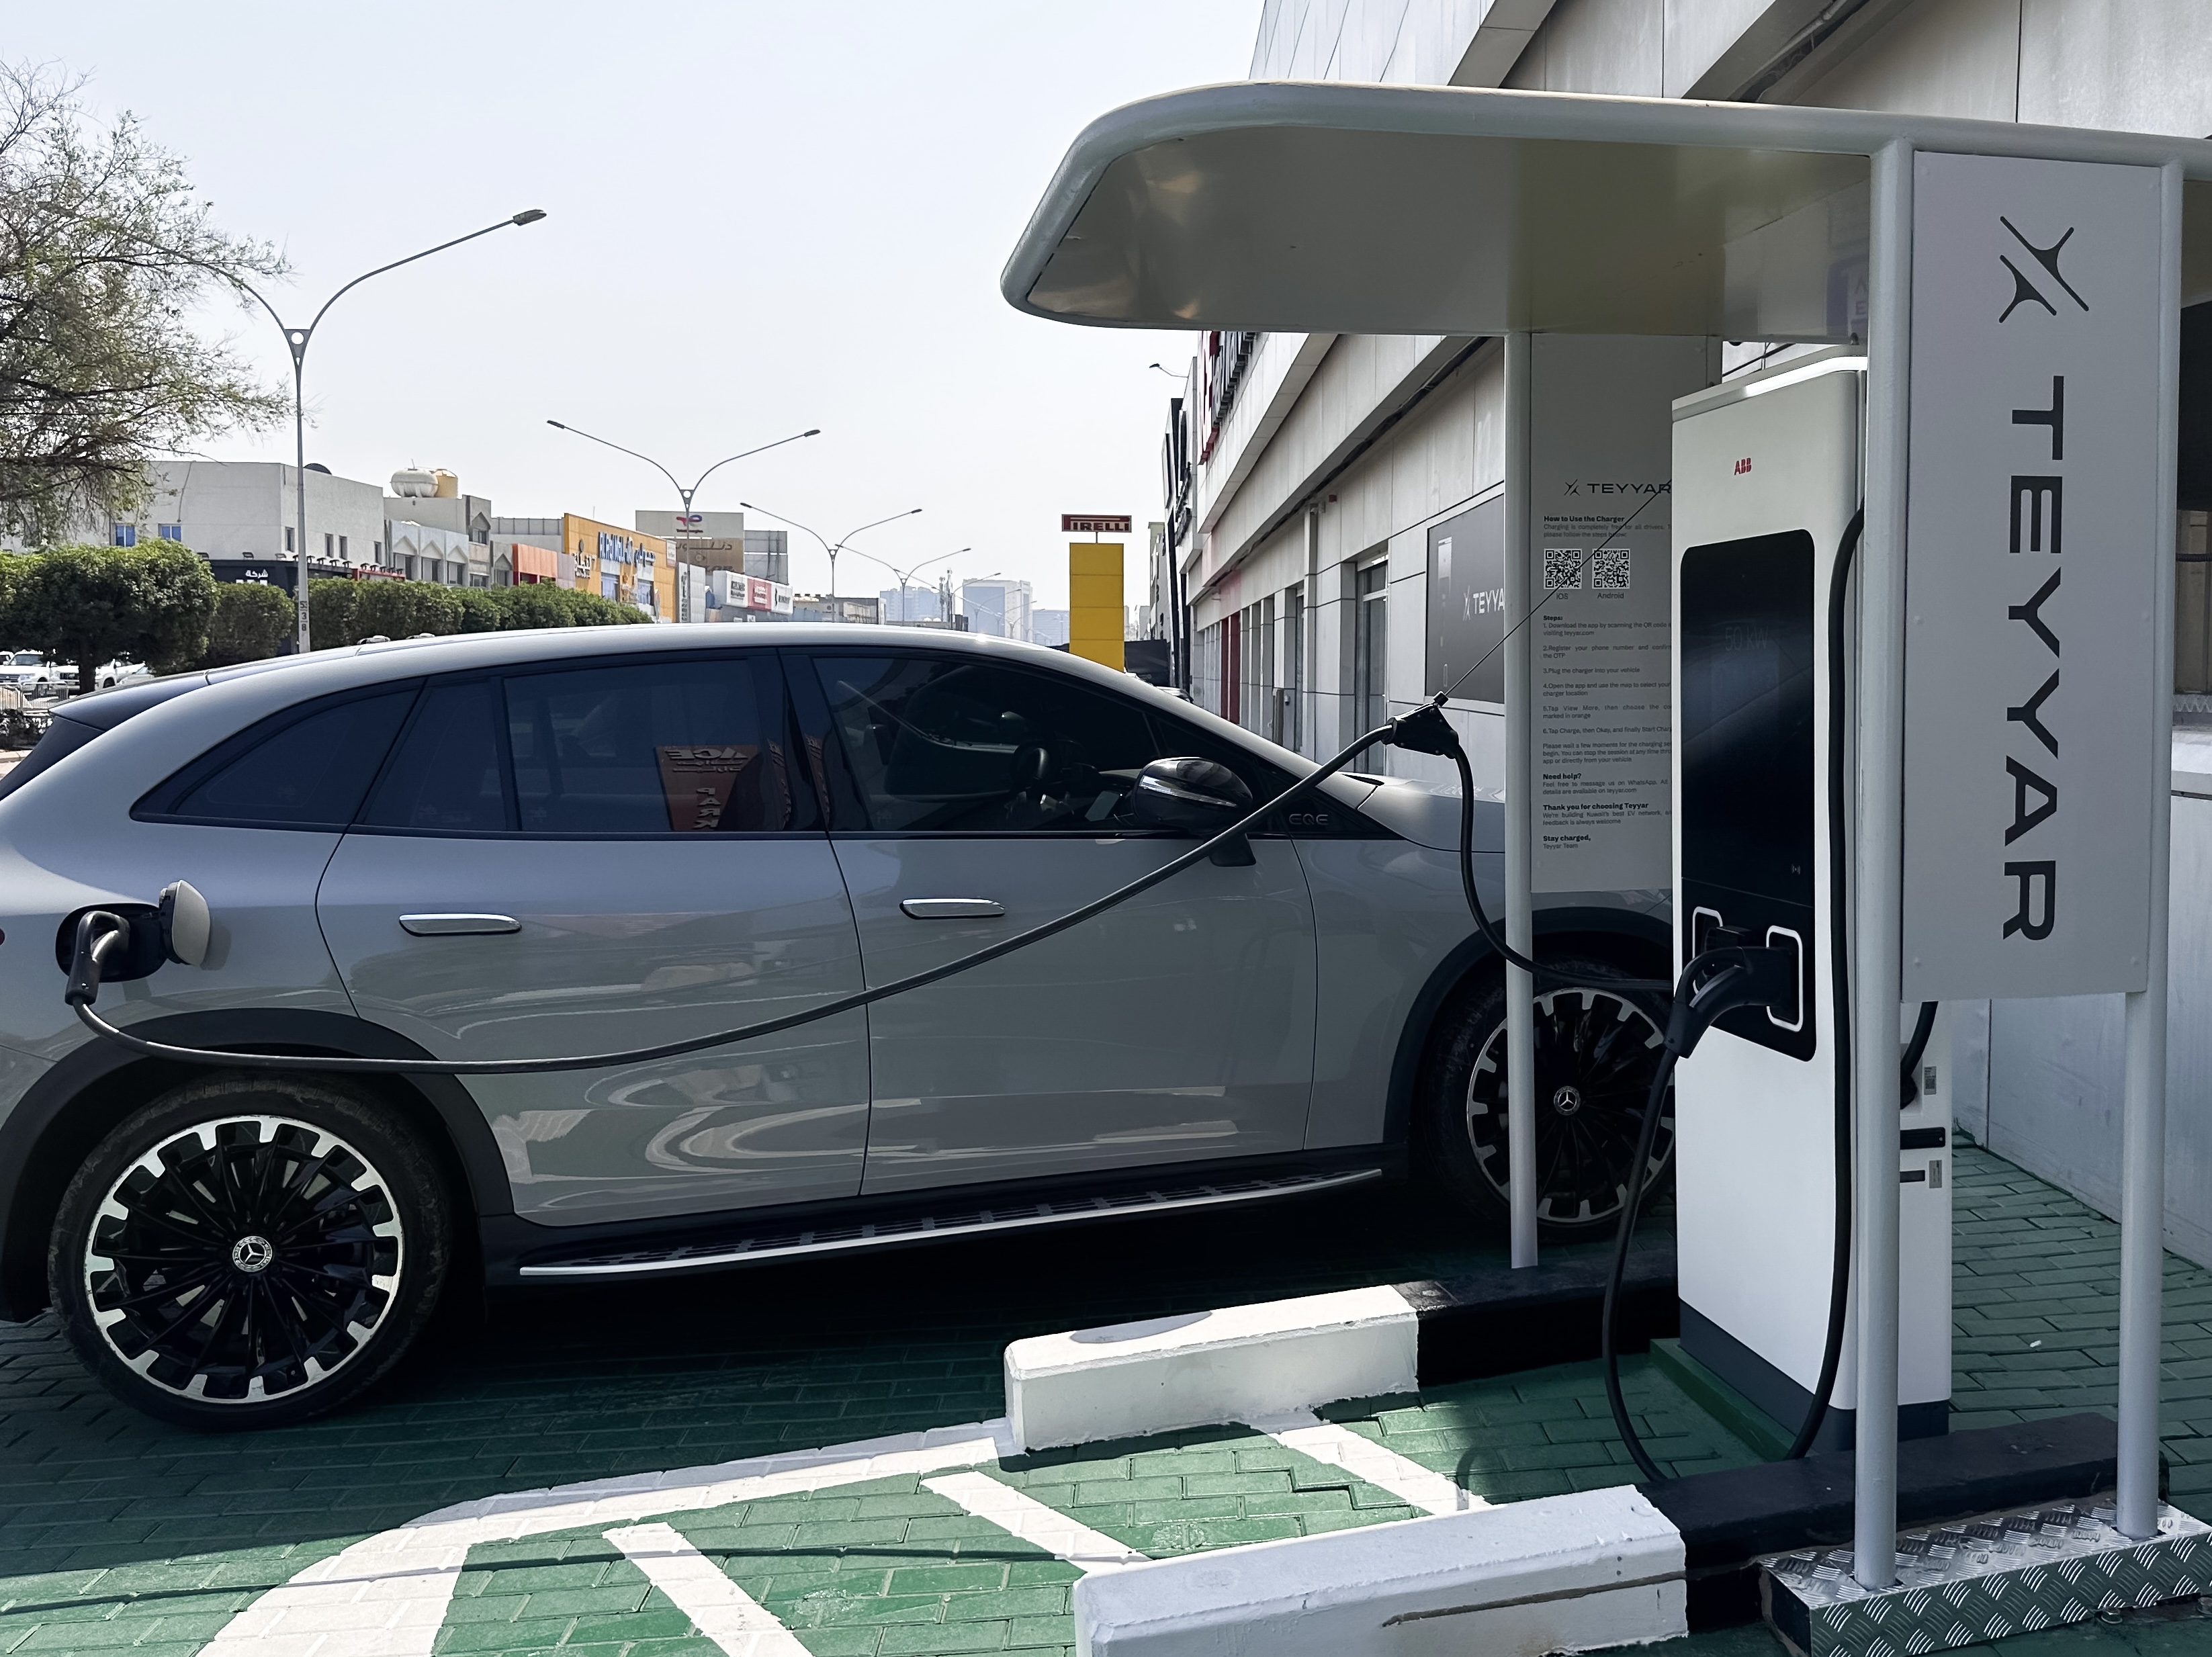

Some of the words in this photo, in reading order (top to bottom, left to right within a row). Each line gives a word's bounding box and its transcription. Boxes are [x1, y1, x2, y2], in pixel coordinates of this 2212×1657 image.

[1734, 457, 1751, 475] ABB
[1587, 483, 1671, 494] TEYYAR
[1063, 515, 1130, 531] PIRELLI
[245, 569, 269, 578] شركة
[1473, 588, 1505, 615] TEYYA
[1725, 626, 1742, 651] 50
[1746, 624, 1769, 650] kW
[2002, 375, 2064, 942] TEYYAR
[1288, 813, 1329, 825] EQE
